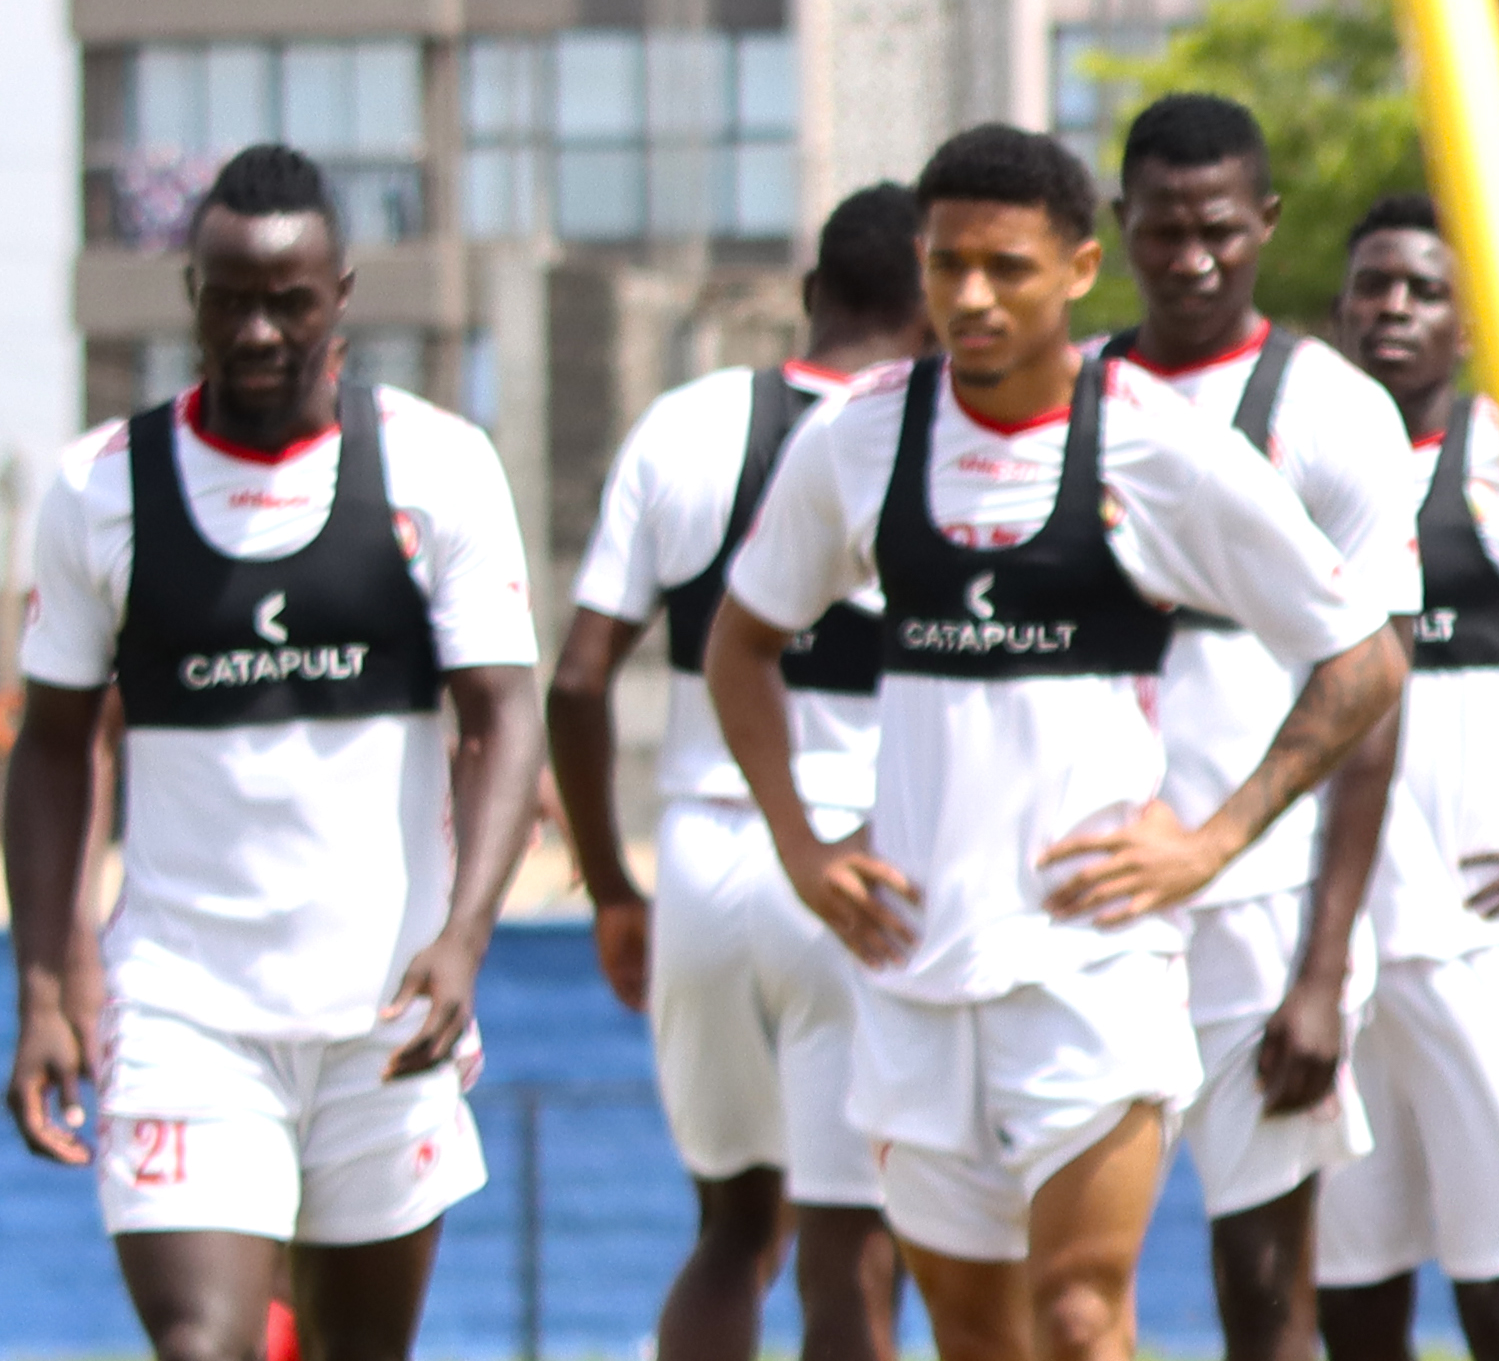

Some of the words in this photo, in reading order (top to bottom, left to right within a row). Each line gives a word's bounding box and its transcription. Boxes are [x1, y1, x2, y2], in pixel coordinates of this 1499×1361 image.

[903, 620, 1077, 654] CATAPULT
[180, 641, 370, 688] CATAPULT
[133, 1118, 188, 1187] 21
